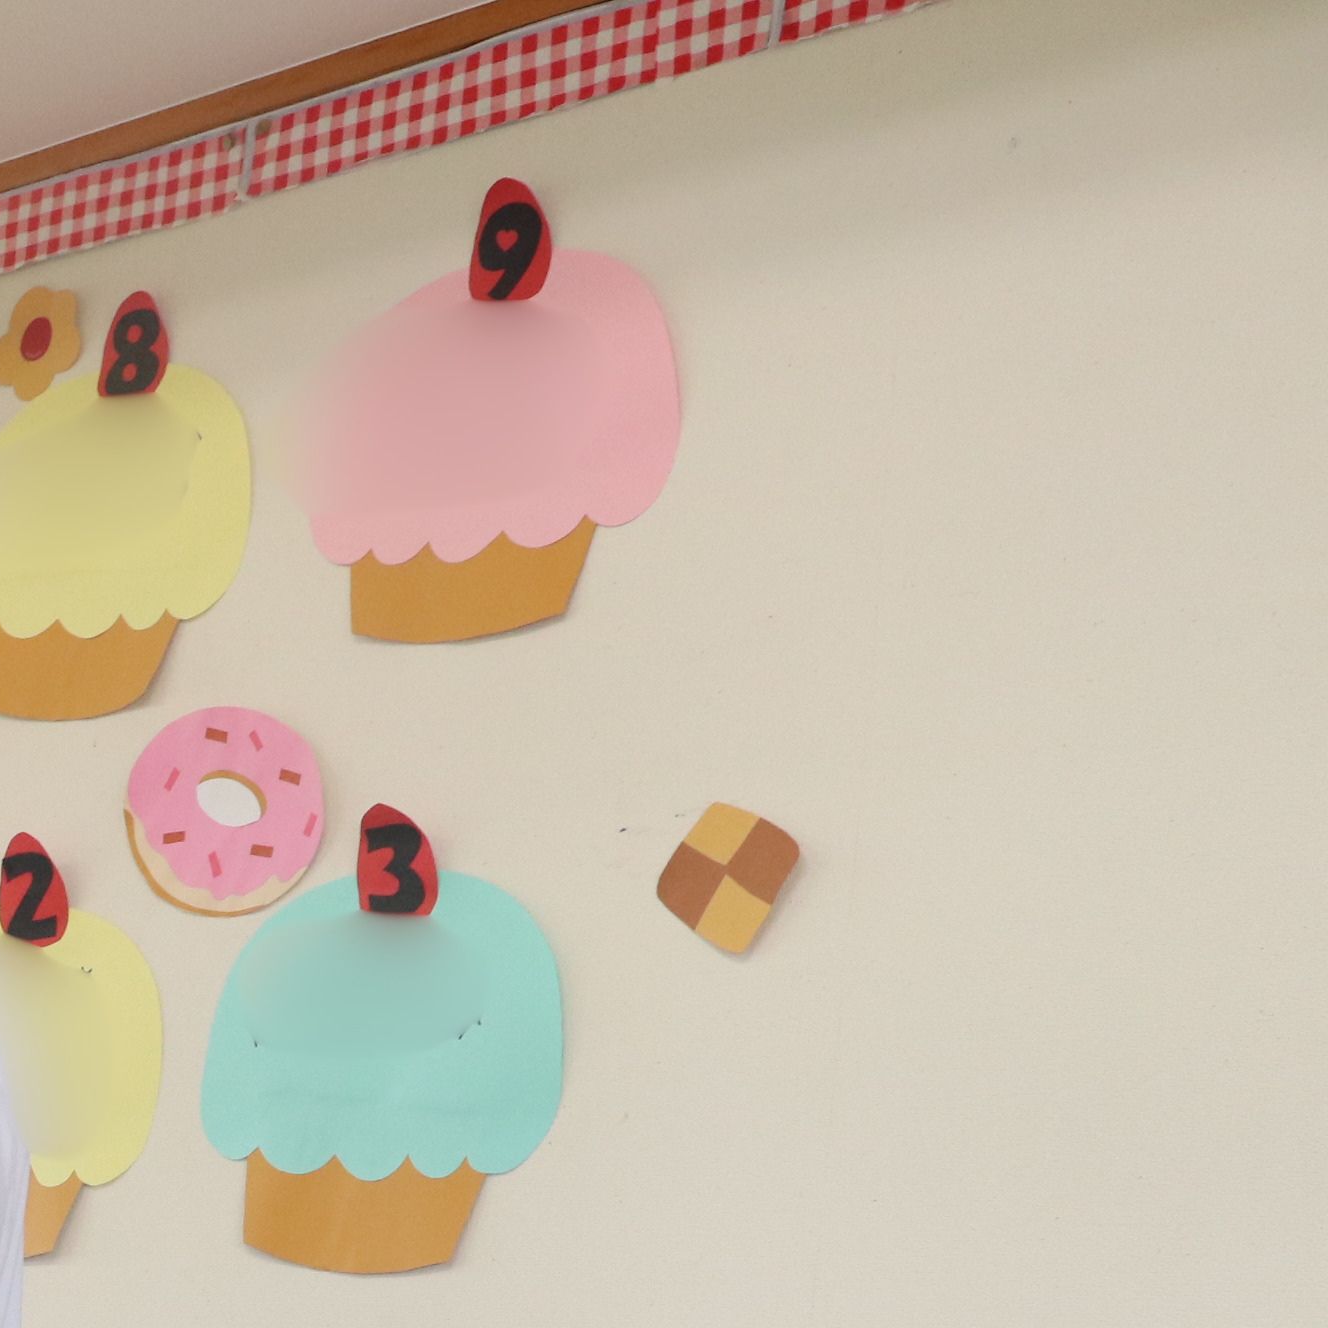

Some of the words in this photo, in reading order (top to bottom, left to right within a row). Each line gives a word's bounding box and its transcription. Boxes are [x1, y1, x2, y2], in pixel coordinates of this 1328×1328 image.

[478, 201, 543, 300] 9
[104, 308, 161, 395] 8
[1, 852, 57, 940] 2
[364, 822, 427, 914] 3
